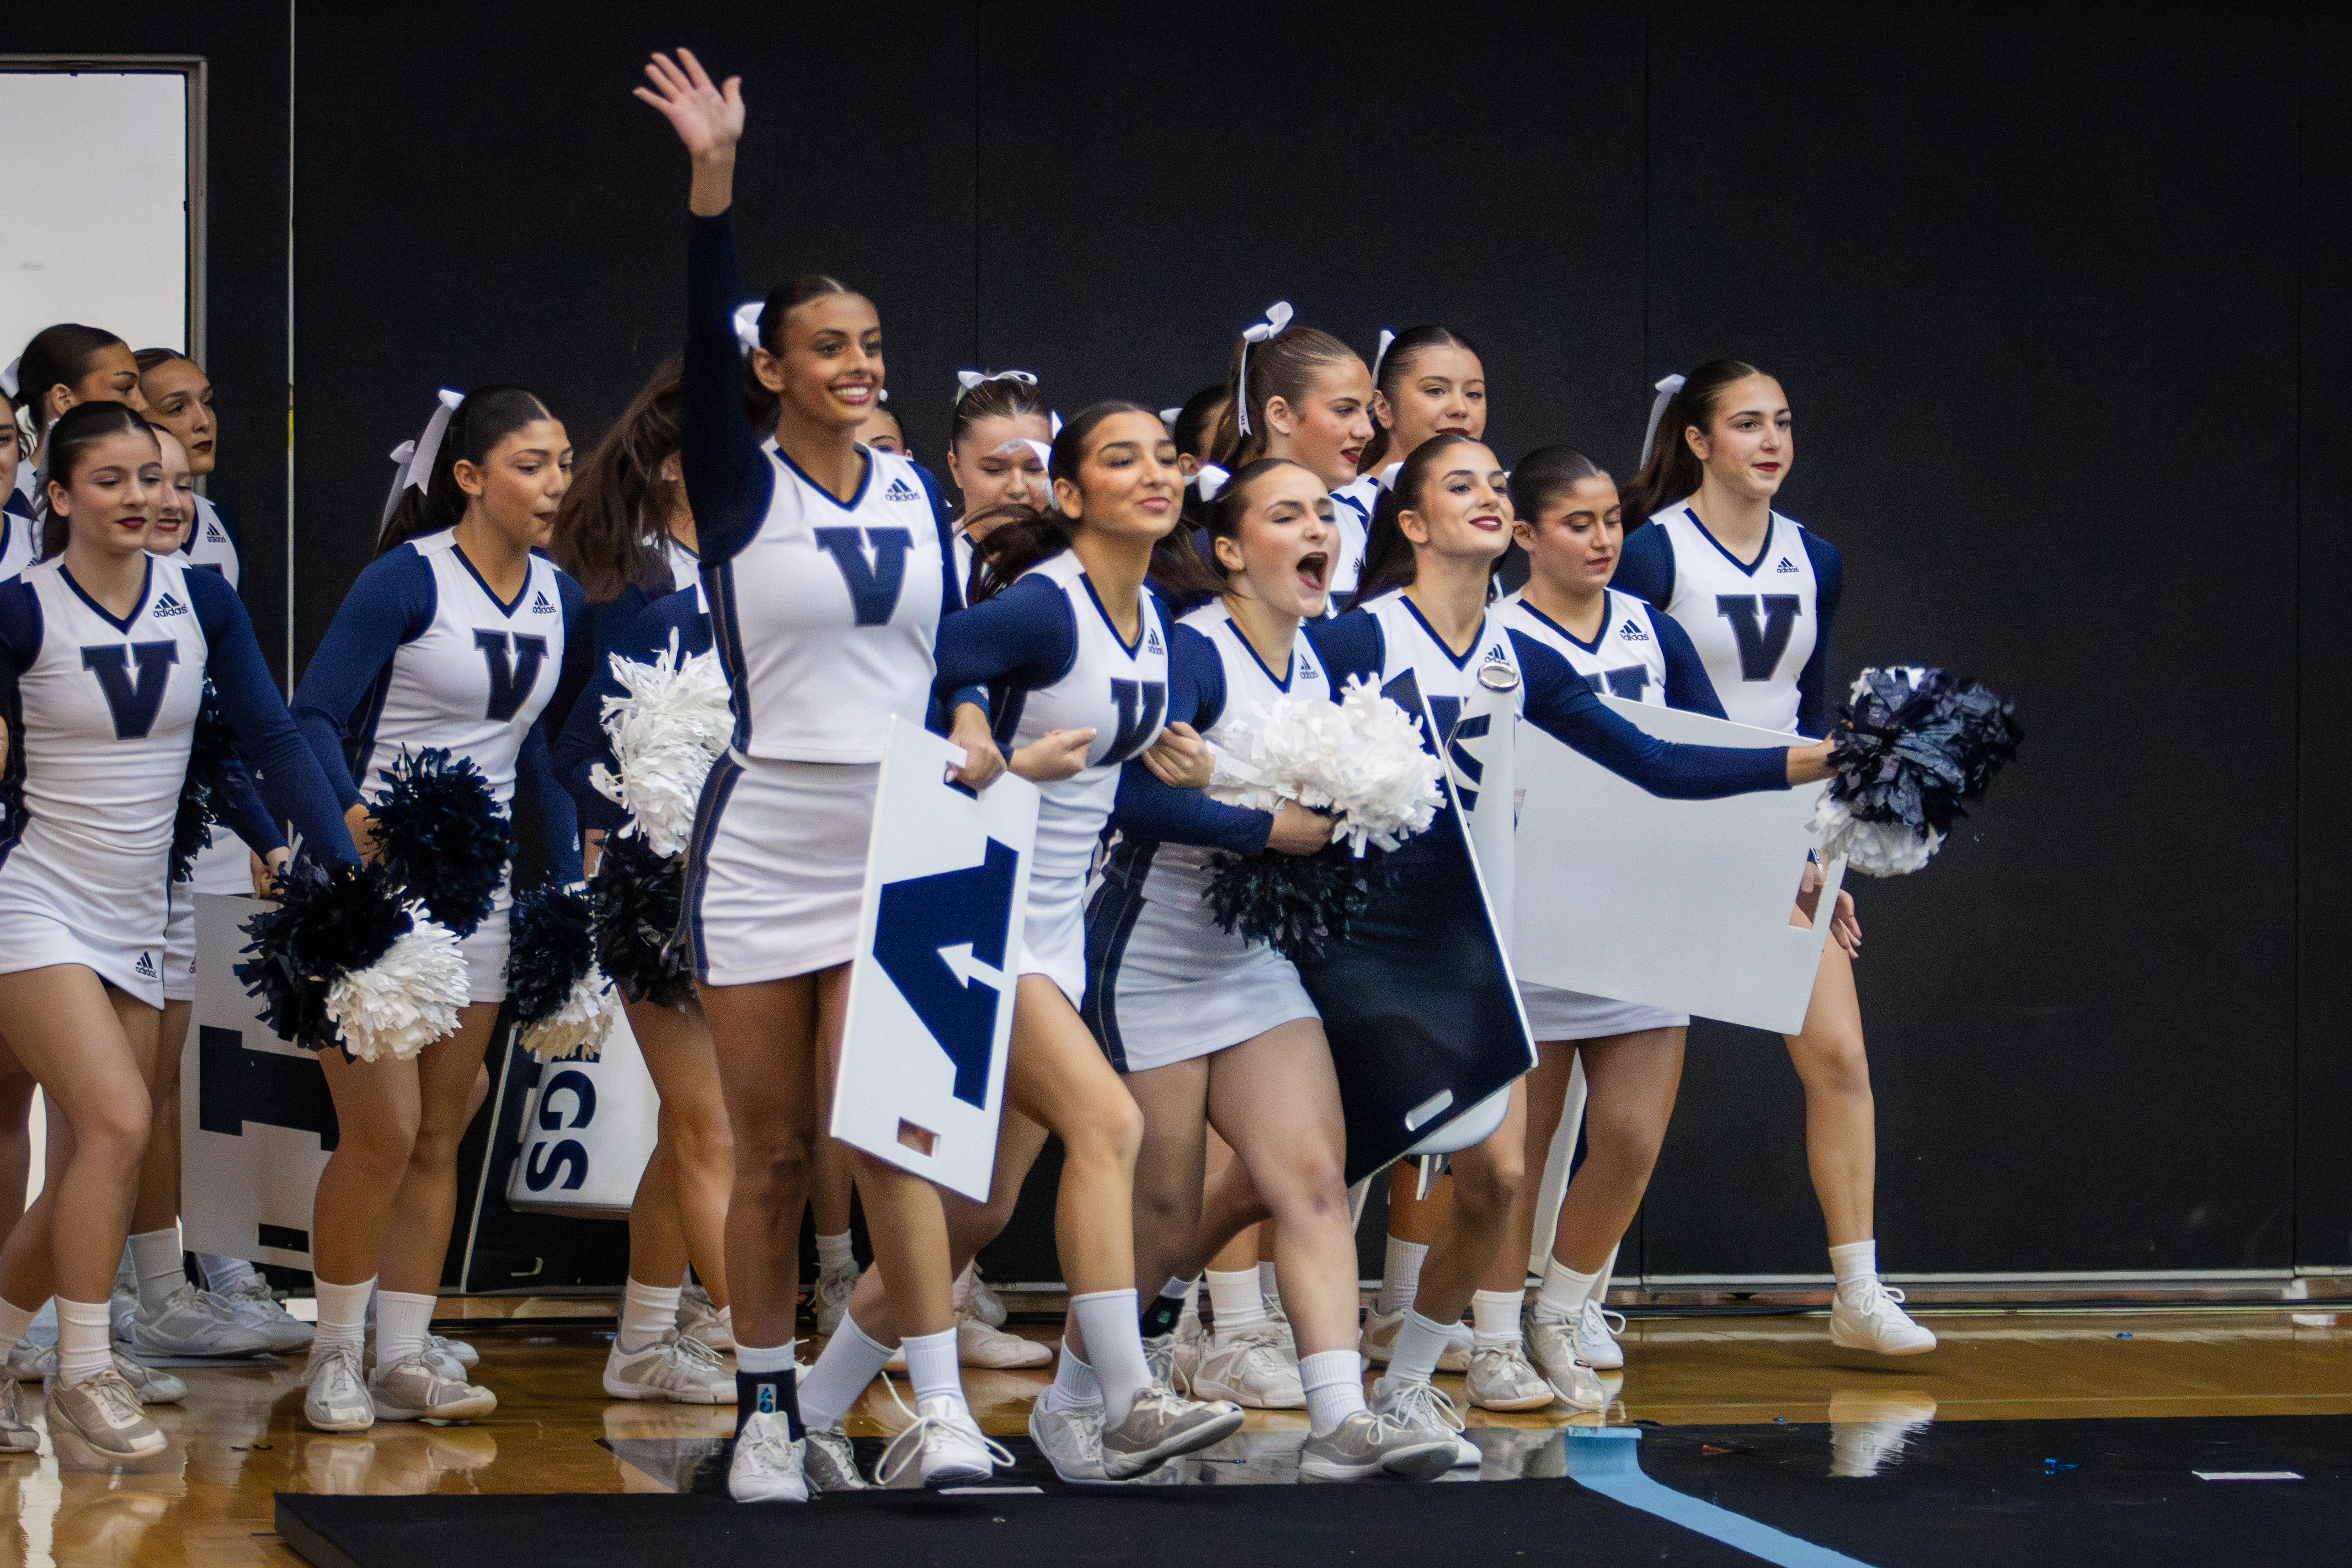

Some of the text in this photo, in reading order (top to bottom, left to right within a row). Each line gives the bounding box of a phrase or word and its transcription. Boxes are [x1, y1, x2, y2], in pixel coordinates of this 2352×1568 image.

[153, 607, 187, 618] adidas
[813, 526, 915, 627] V
[472, 628, 549, 722] V
[1715, 593, 1803, 682] V
[80, 640, 180, 741] V
[1093, 677, 1165, 767] V
[873, 836, 1019, 1111] V
